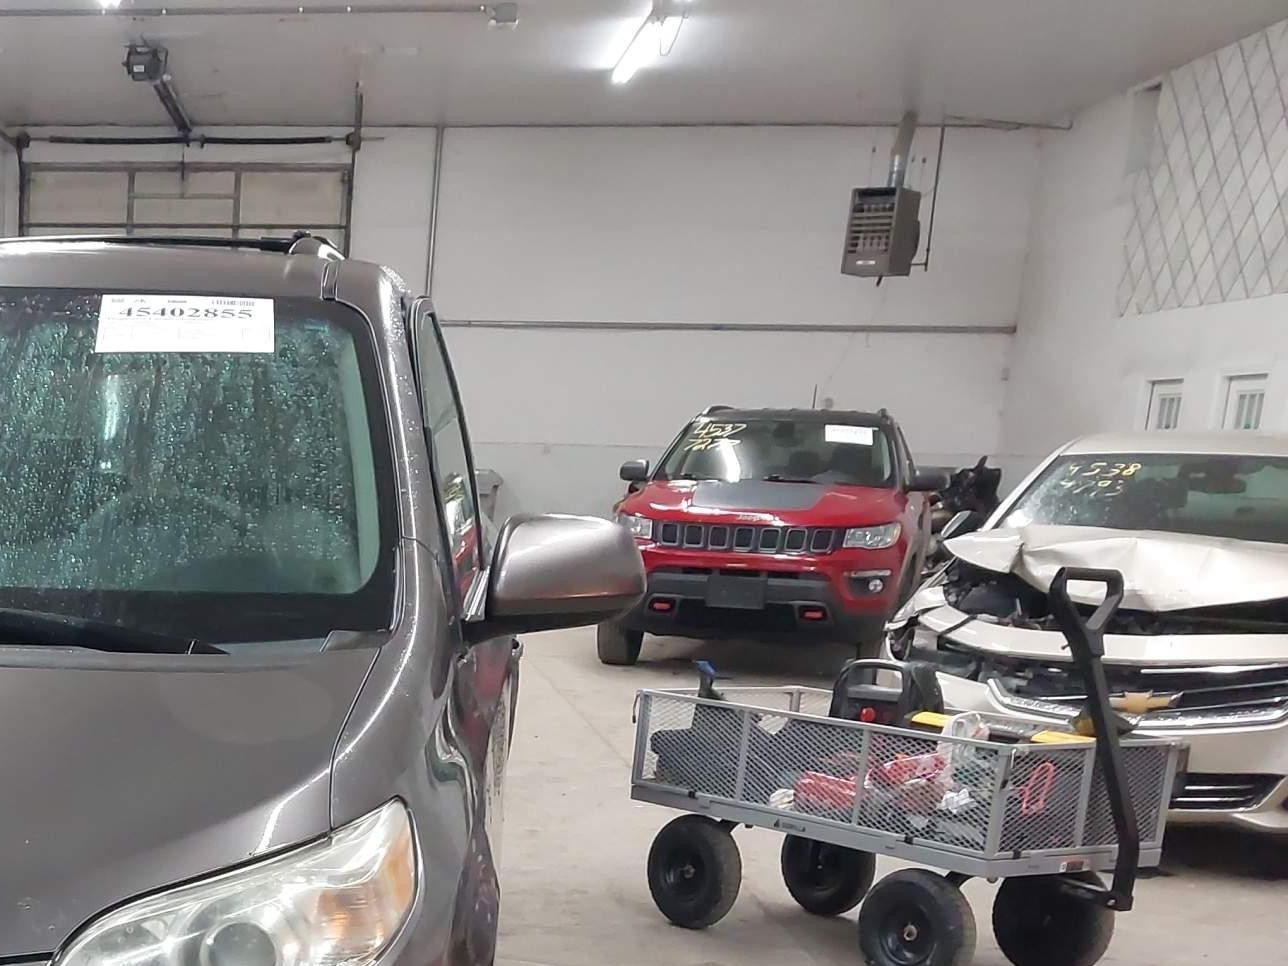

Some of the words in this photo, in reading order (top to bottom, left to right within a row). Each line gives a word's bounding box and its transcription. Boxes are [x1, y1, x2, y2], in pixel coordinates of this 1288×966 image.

[119, 307, 253, 319] 45402855
[693, 423, 748, 438] 4537
[1069, 462, 1142, 476] 4538
